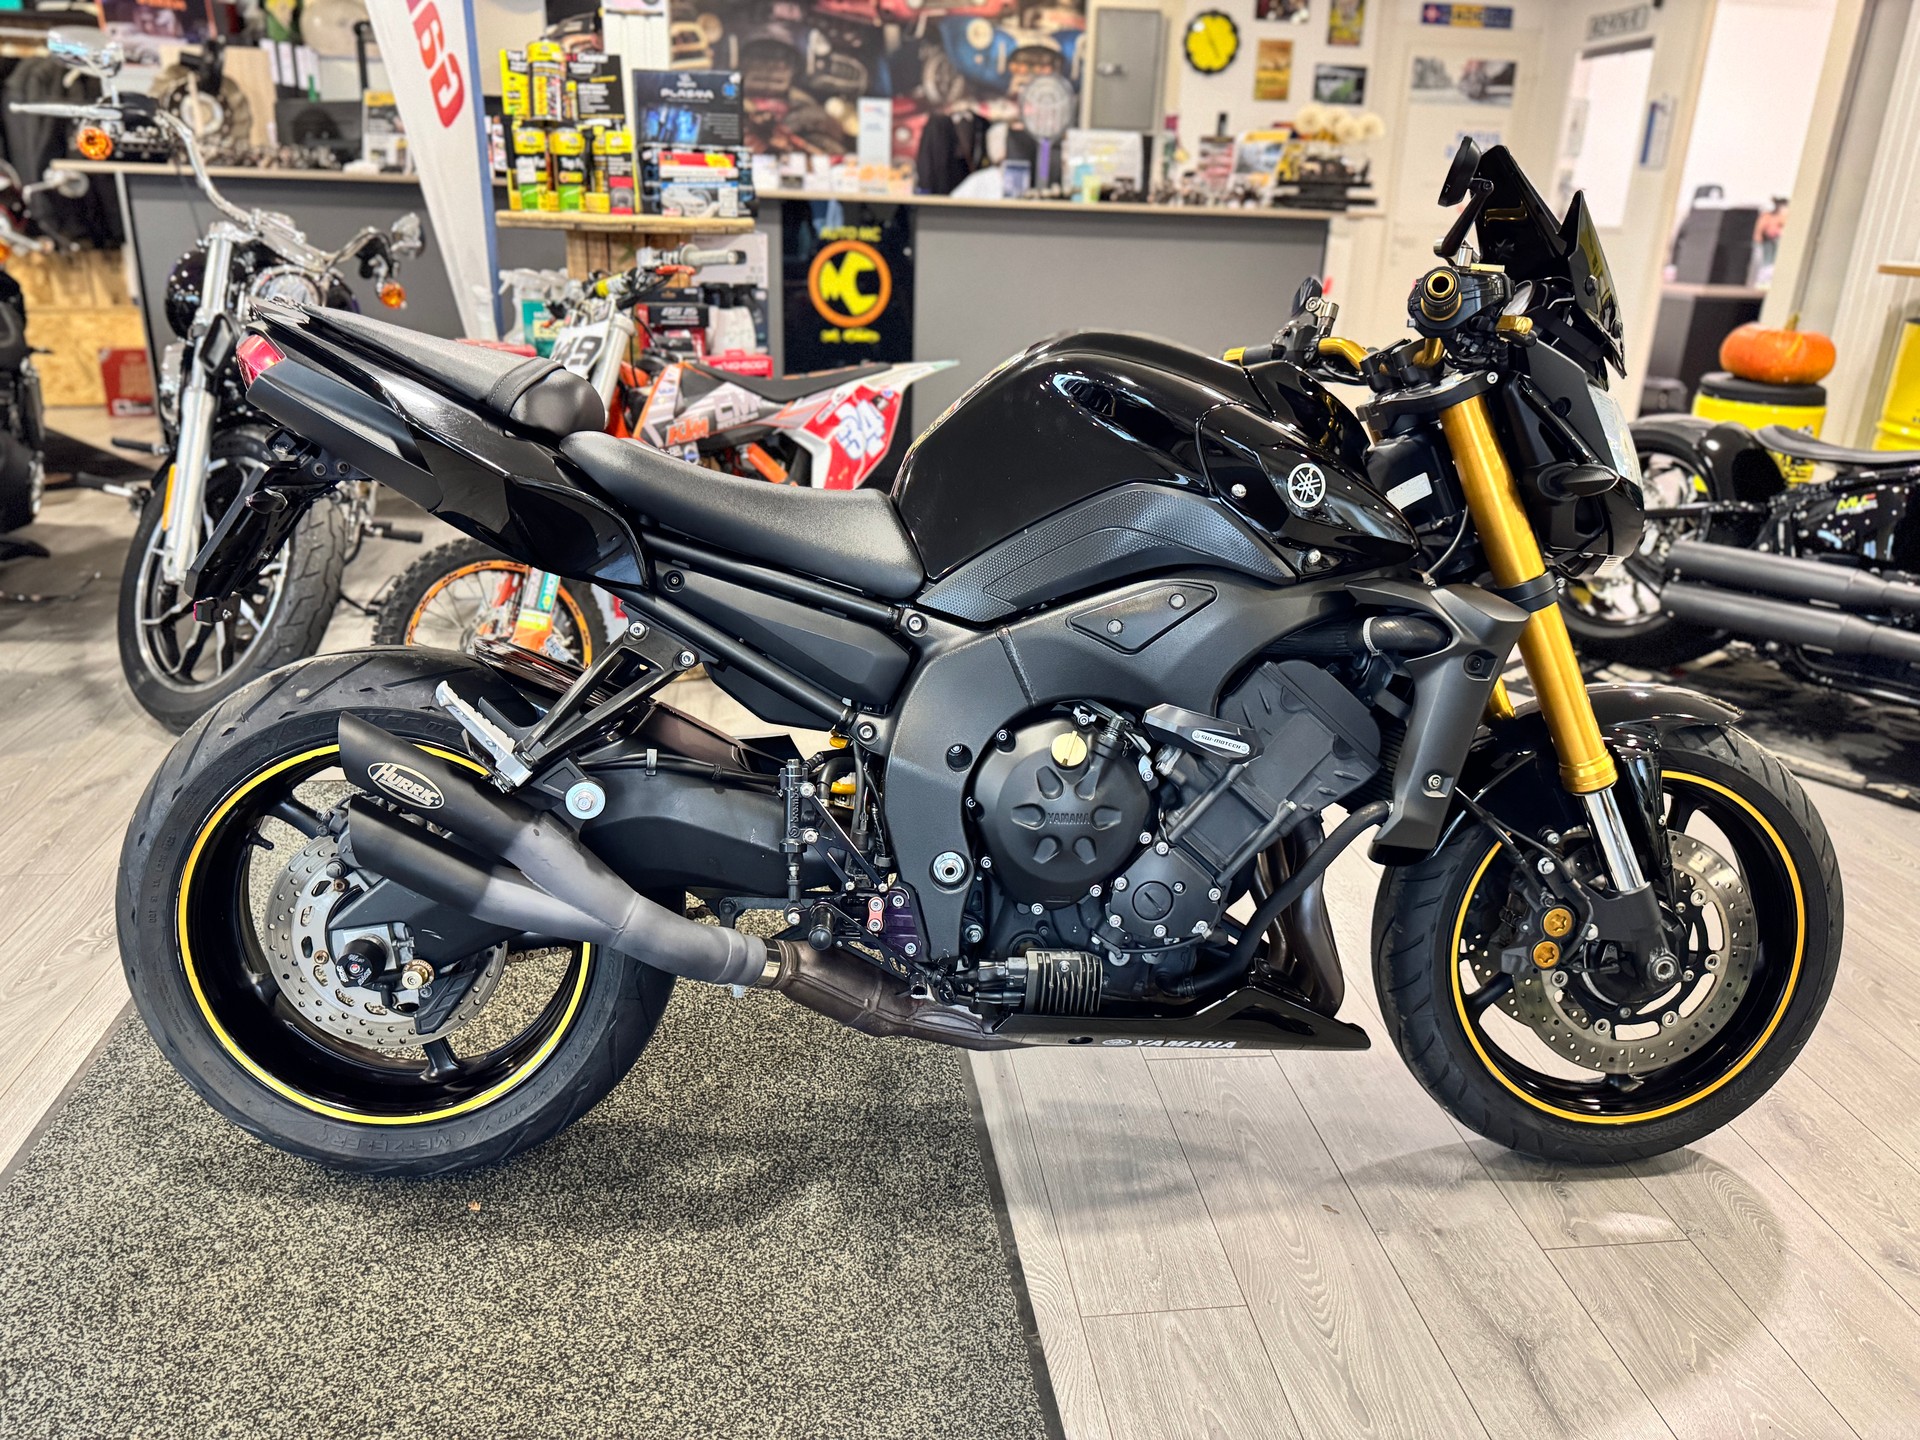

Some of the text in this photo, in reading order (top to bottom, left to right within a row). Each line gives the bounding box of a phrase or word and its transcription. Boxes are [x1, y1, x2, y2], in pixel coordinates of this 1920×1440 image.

[665, 416, 710, 447] KTM
[372, 762, 440, 804] HURRIC
[1047, 812, 1091, 825] YAMAHA
[1135, 1039, 1238, 1050] YAMAHA
